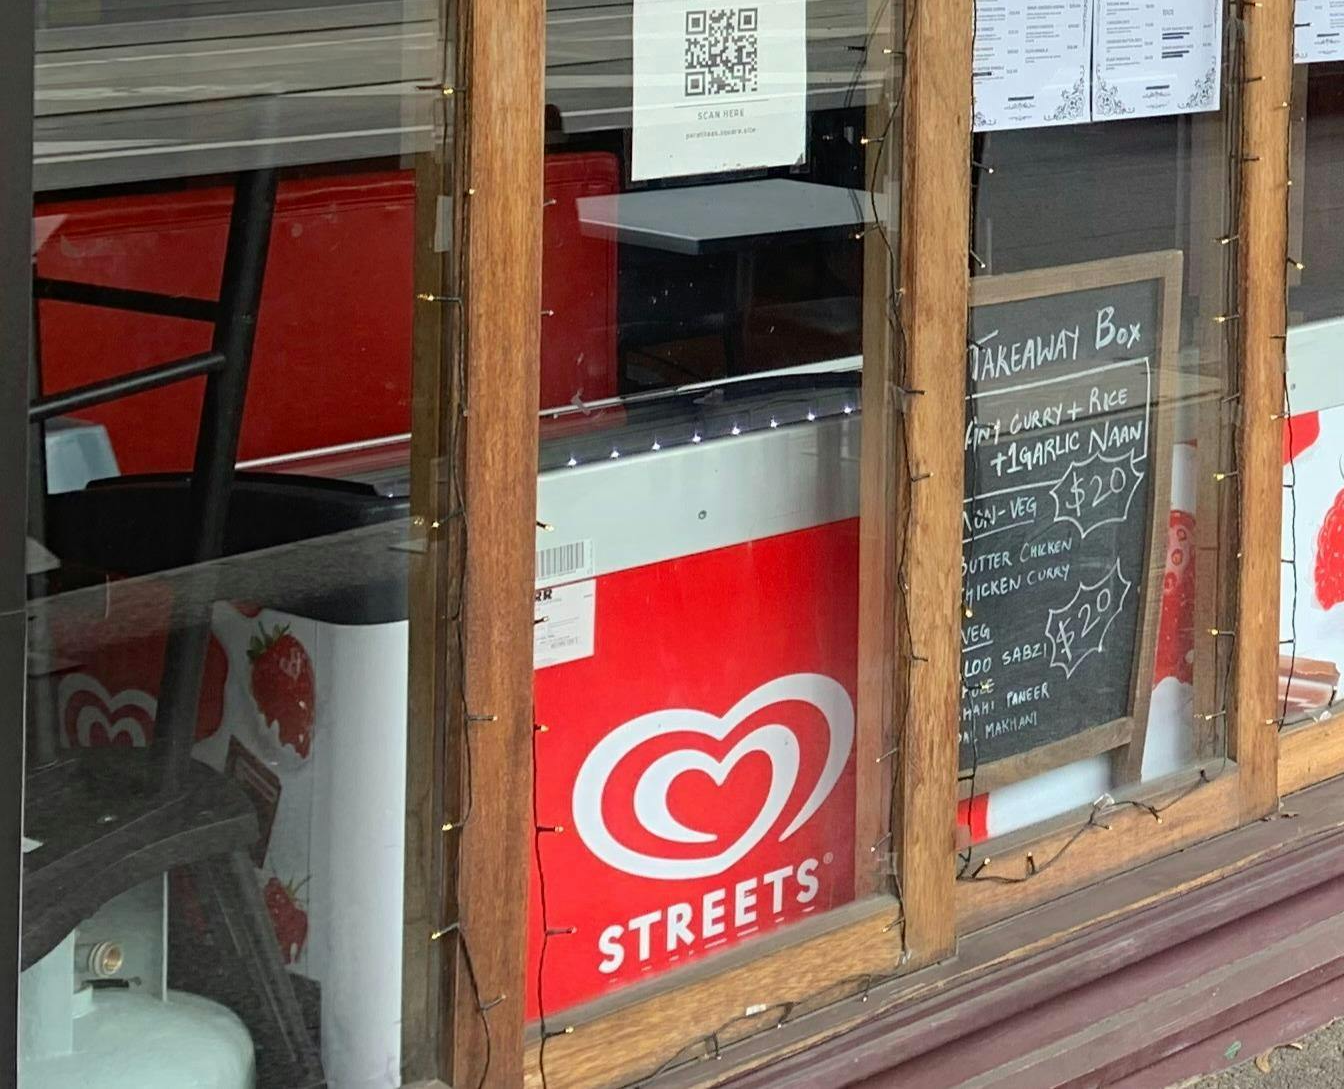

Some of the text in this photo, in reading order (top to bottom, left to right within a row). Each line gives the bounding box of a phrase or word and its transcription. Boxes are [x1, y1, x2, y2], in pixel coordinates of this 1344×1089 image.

[697, 108, 745, 121] SCAN HERE
[969, 325, 1080, 381] TAKEAWAY
[1010, 403, 1063, 435] CURRY
[1067, 401, 1083, 420] +
[1088, 420, 1144, 454] NAAN
[1065, 466, 1127, 517] $20
[1019, 538, 1073, 563] CHICKEN
[962, 563, 1071, 604] HICKEN CURRY
[961, 623, 991, 646] VEG
[1056, 588, 1111, 662] $20
[963, 643, 1048, 678] LOO SABZI
[1006, 682, 1050, 708] PANEER
[985, 711, 1038, 739] MAKHANI
[599, 856, 819, 975] STREETS
